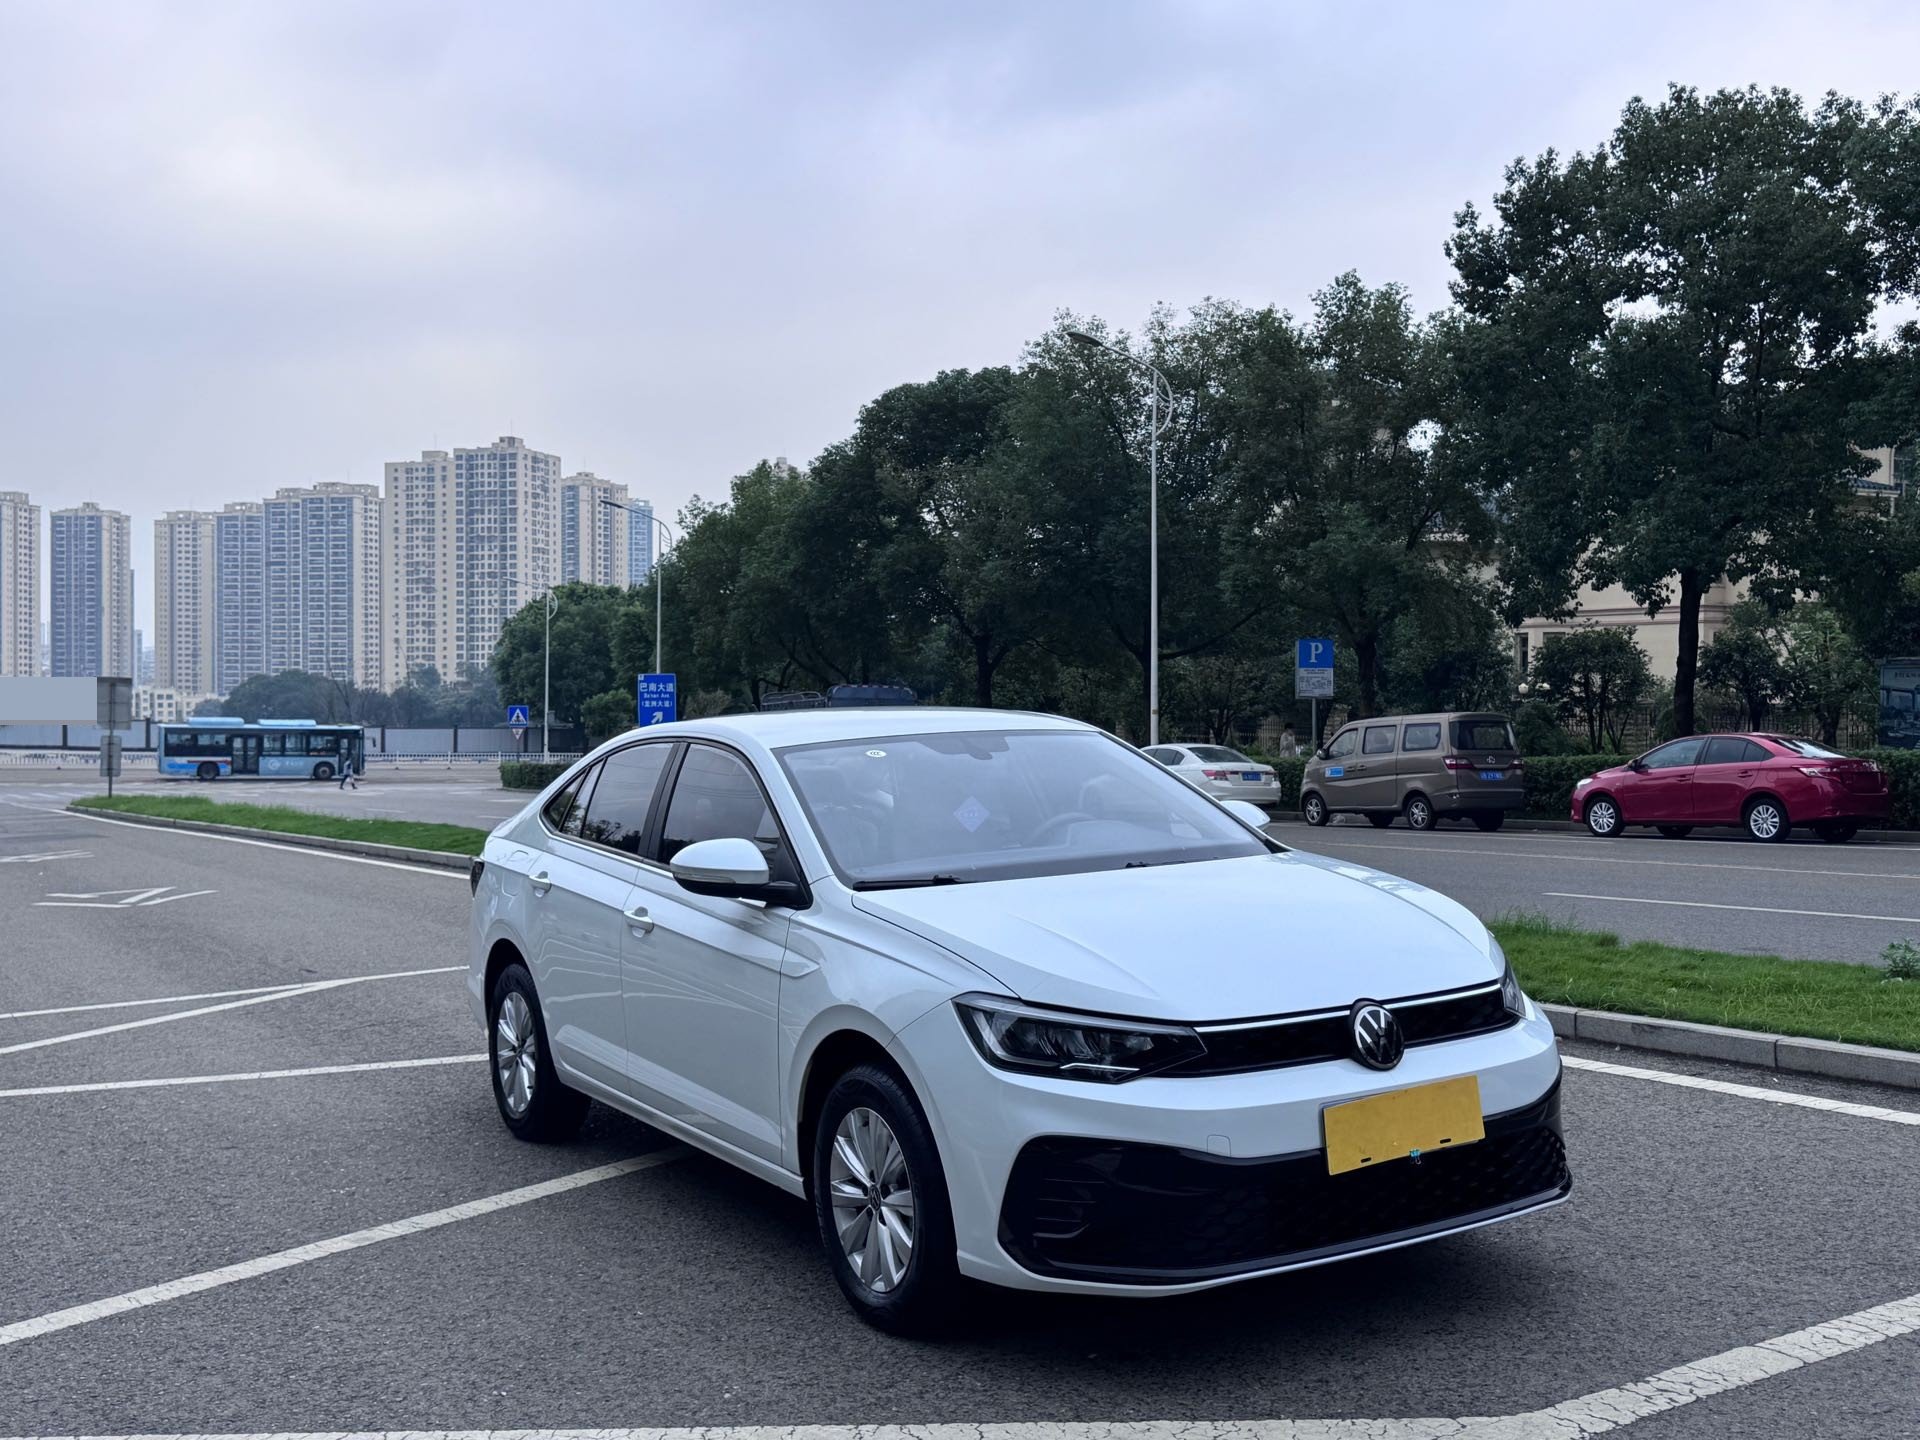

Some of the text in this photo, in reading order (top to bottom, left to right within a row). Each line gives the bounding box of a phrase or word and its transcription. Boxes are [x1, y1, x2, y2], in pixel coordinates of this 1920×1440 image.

[1310, 642, 1323, 662] P
[639, 682, 674, 692] 巴南大道
